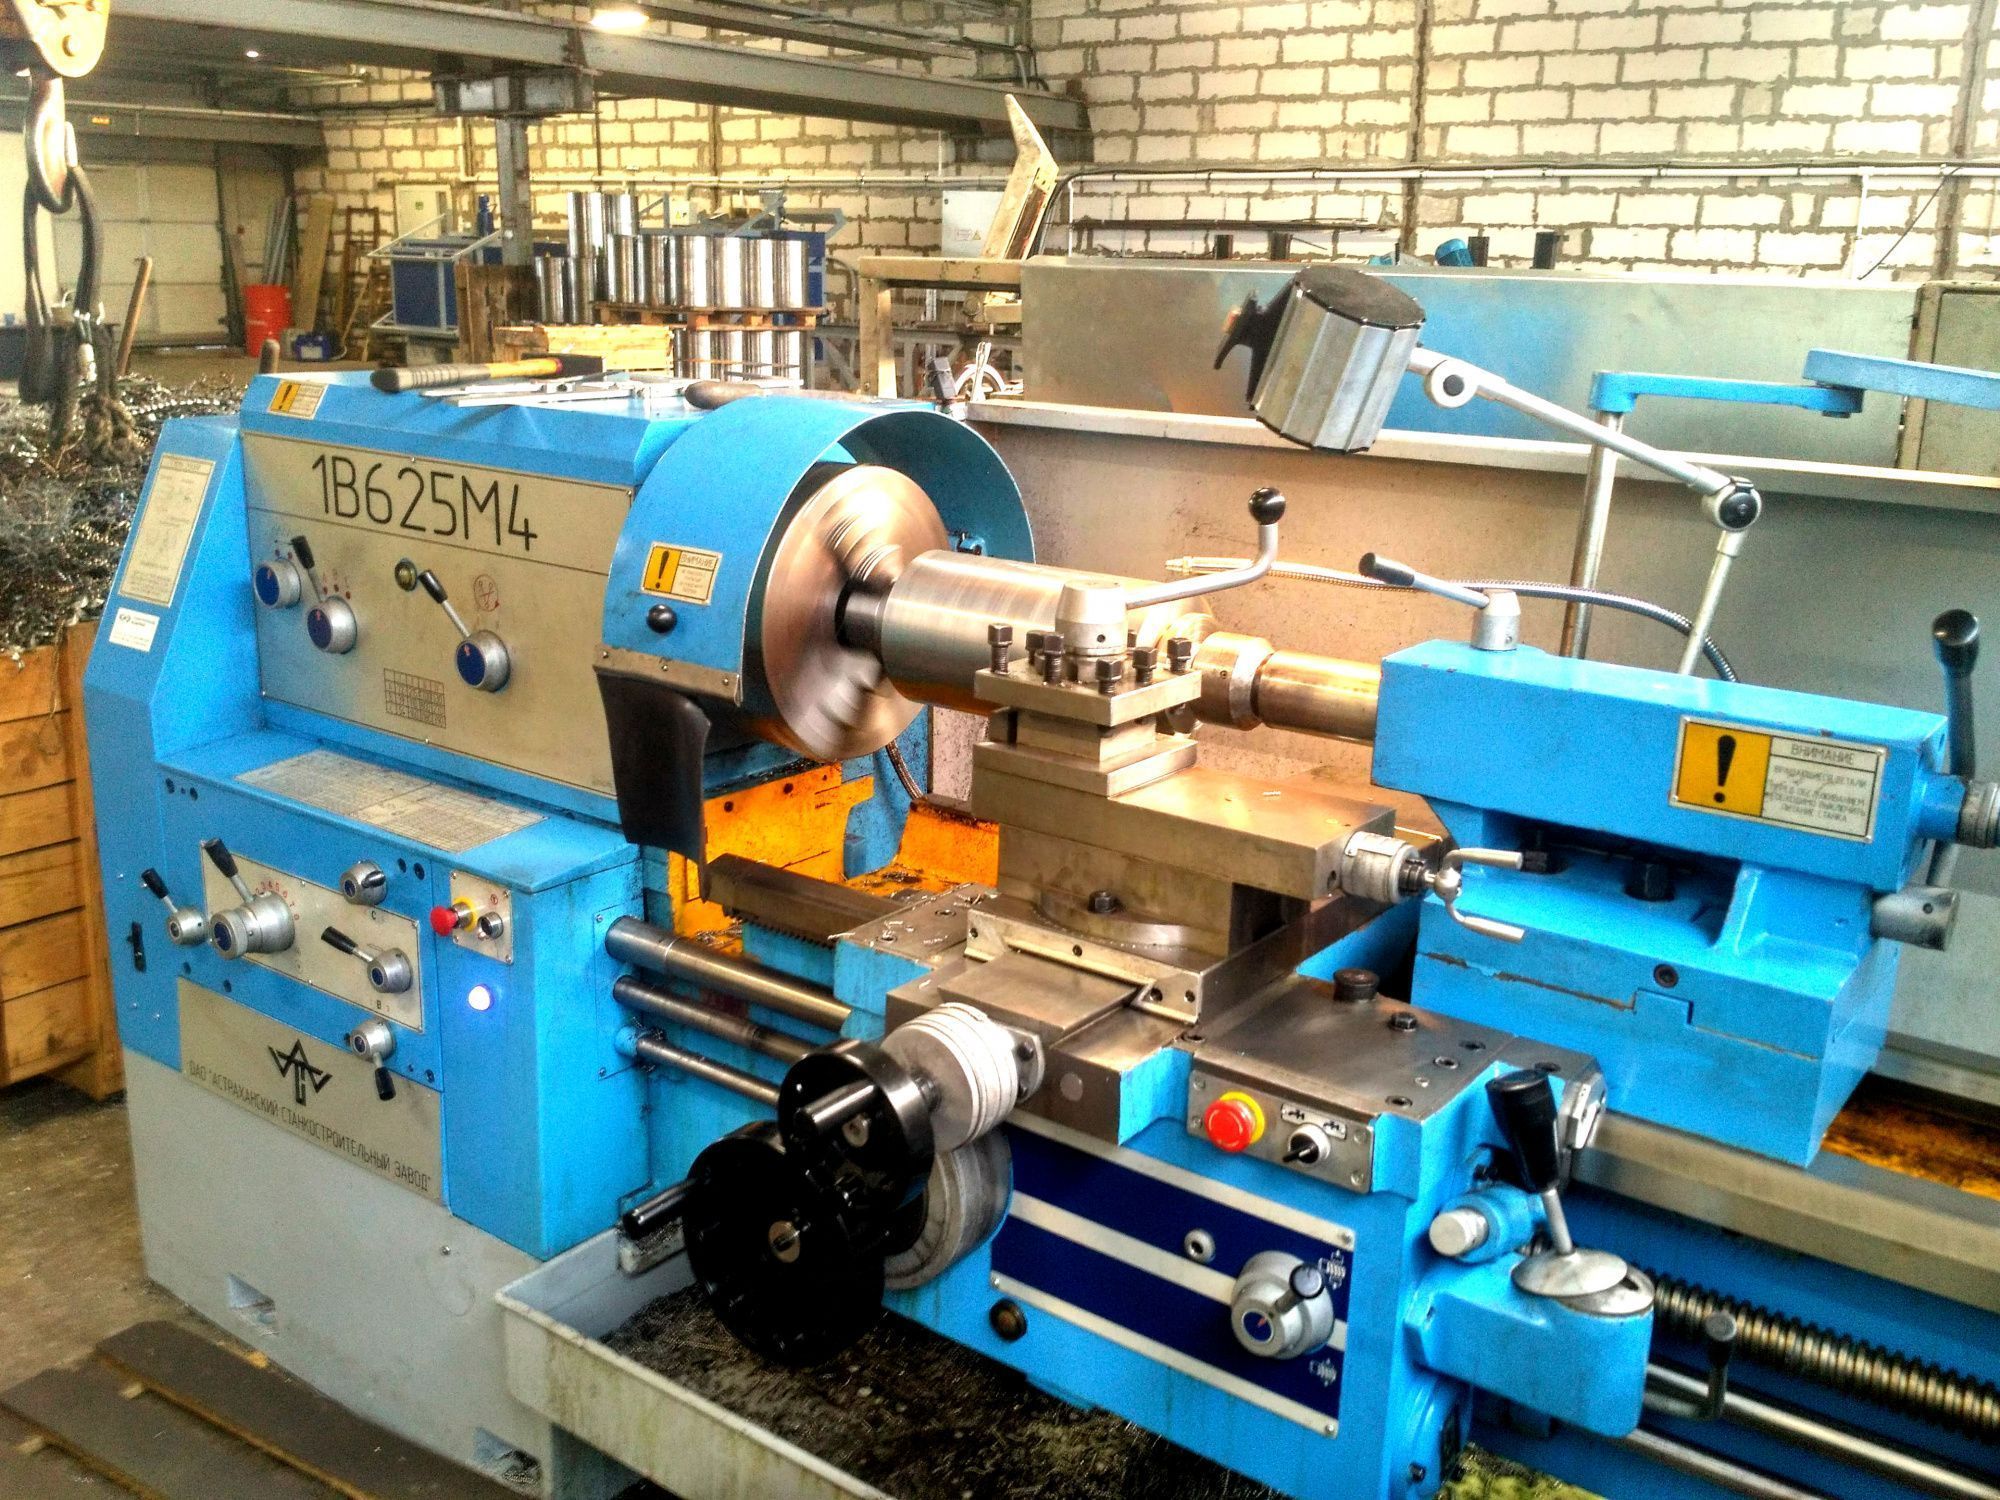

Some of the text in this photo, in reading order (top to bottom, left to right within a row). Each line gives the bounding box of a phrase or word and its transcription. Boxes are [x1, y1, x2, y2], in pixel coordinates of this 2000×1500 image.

[311, 454, 538, 551] 1В625М4
[1791, 743, 1854, 765] ВНИМАНИЕ
[281, 1106, 390, 1171] СТАНКОСТРОИТЕЛЬНЫЙ
